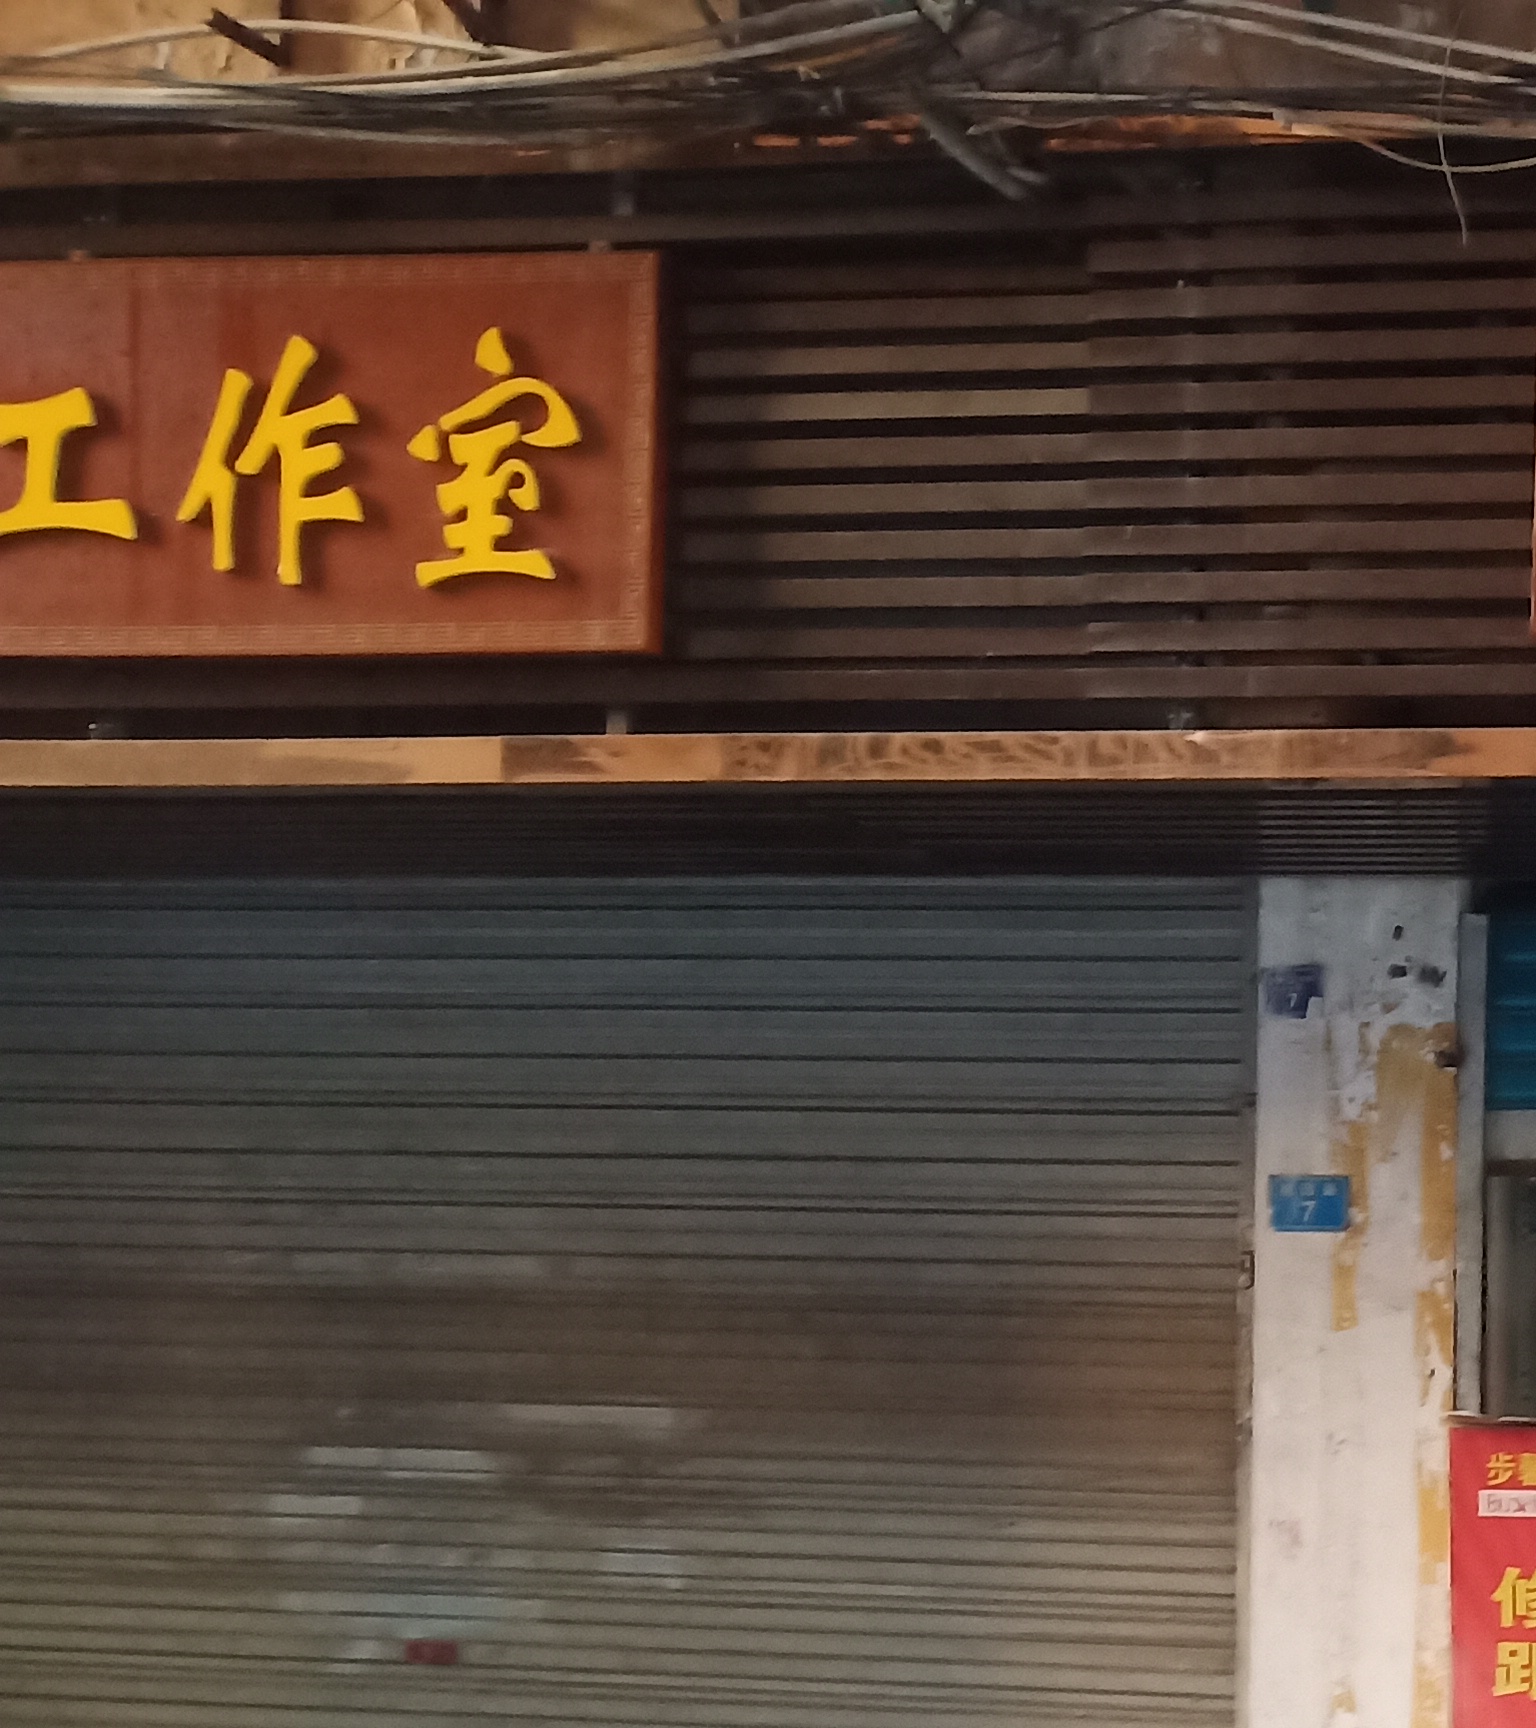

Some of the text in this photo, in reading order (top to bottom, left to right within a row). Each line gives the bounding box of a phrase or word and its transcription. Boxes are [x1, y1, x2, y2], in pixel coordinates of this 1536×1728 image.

[0, 326, 583, 590] 工作室
[1301, 1199, 1317, 1222] 7
